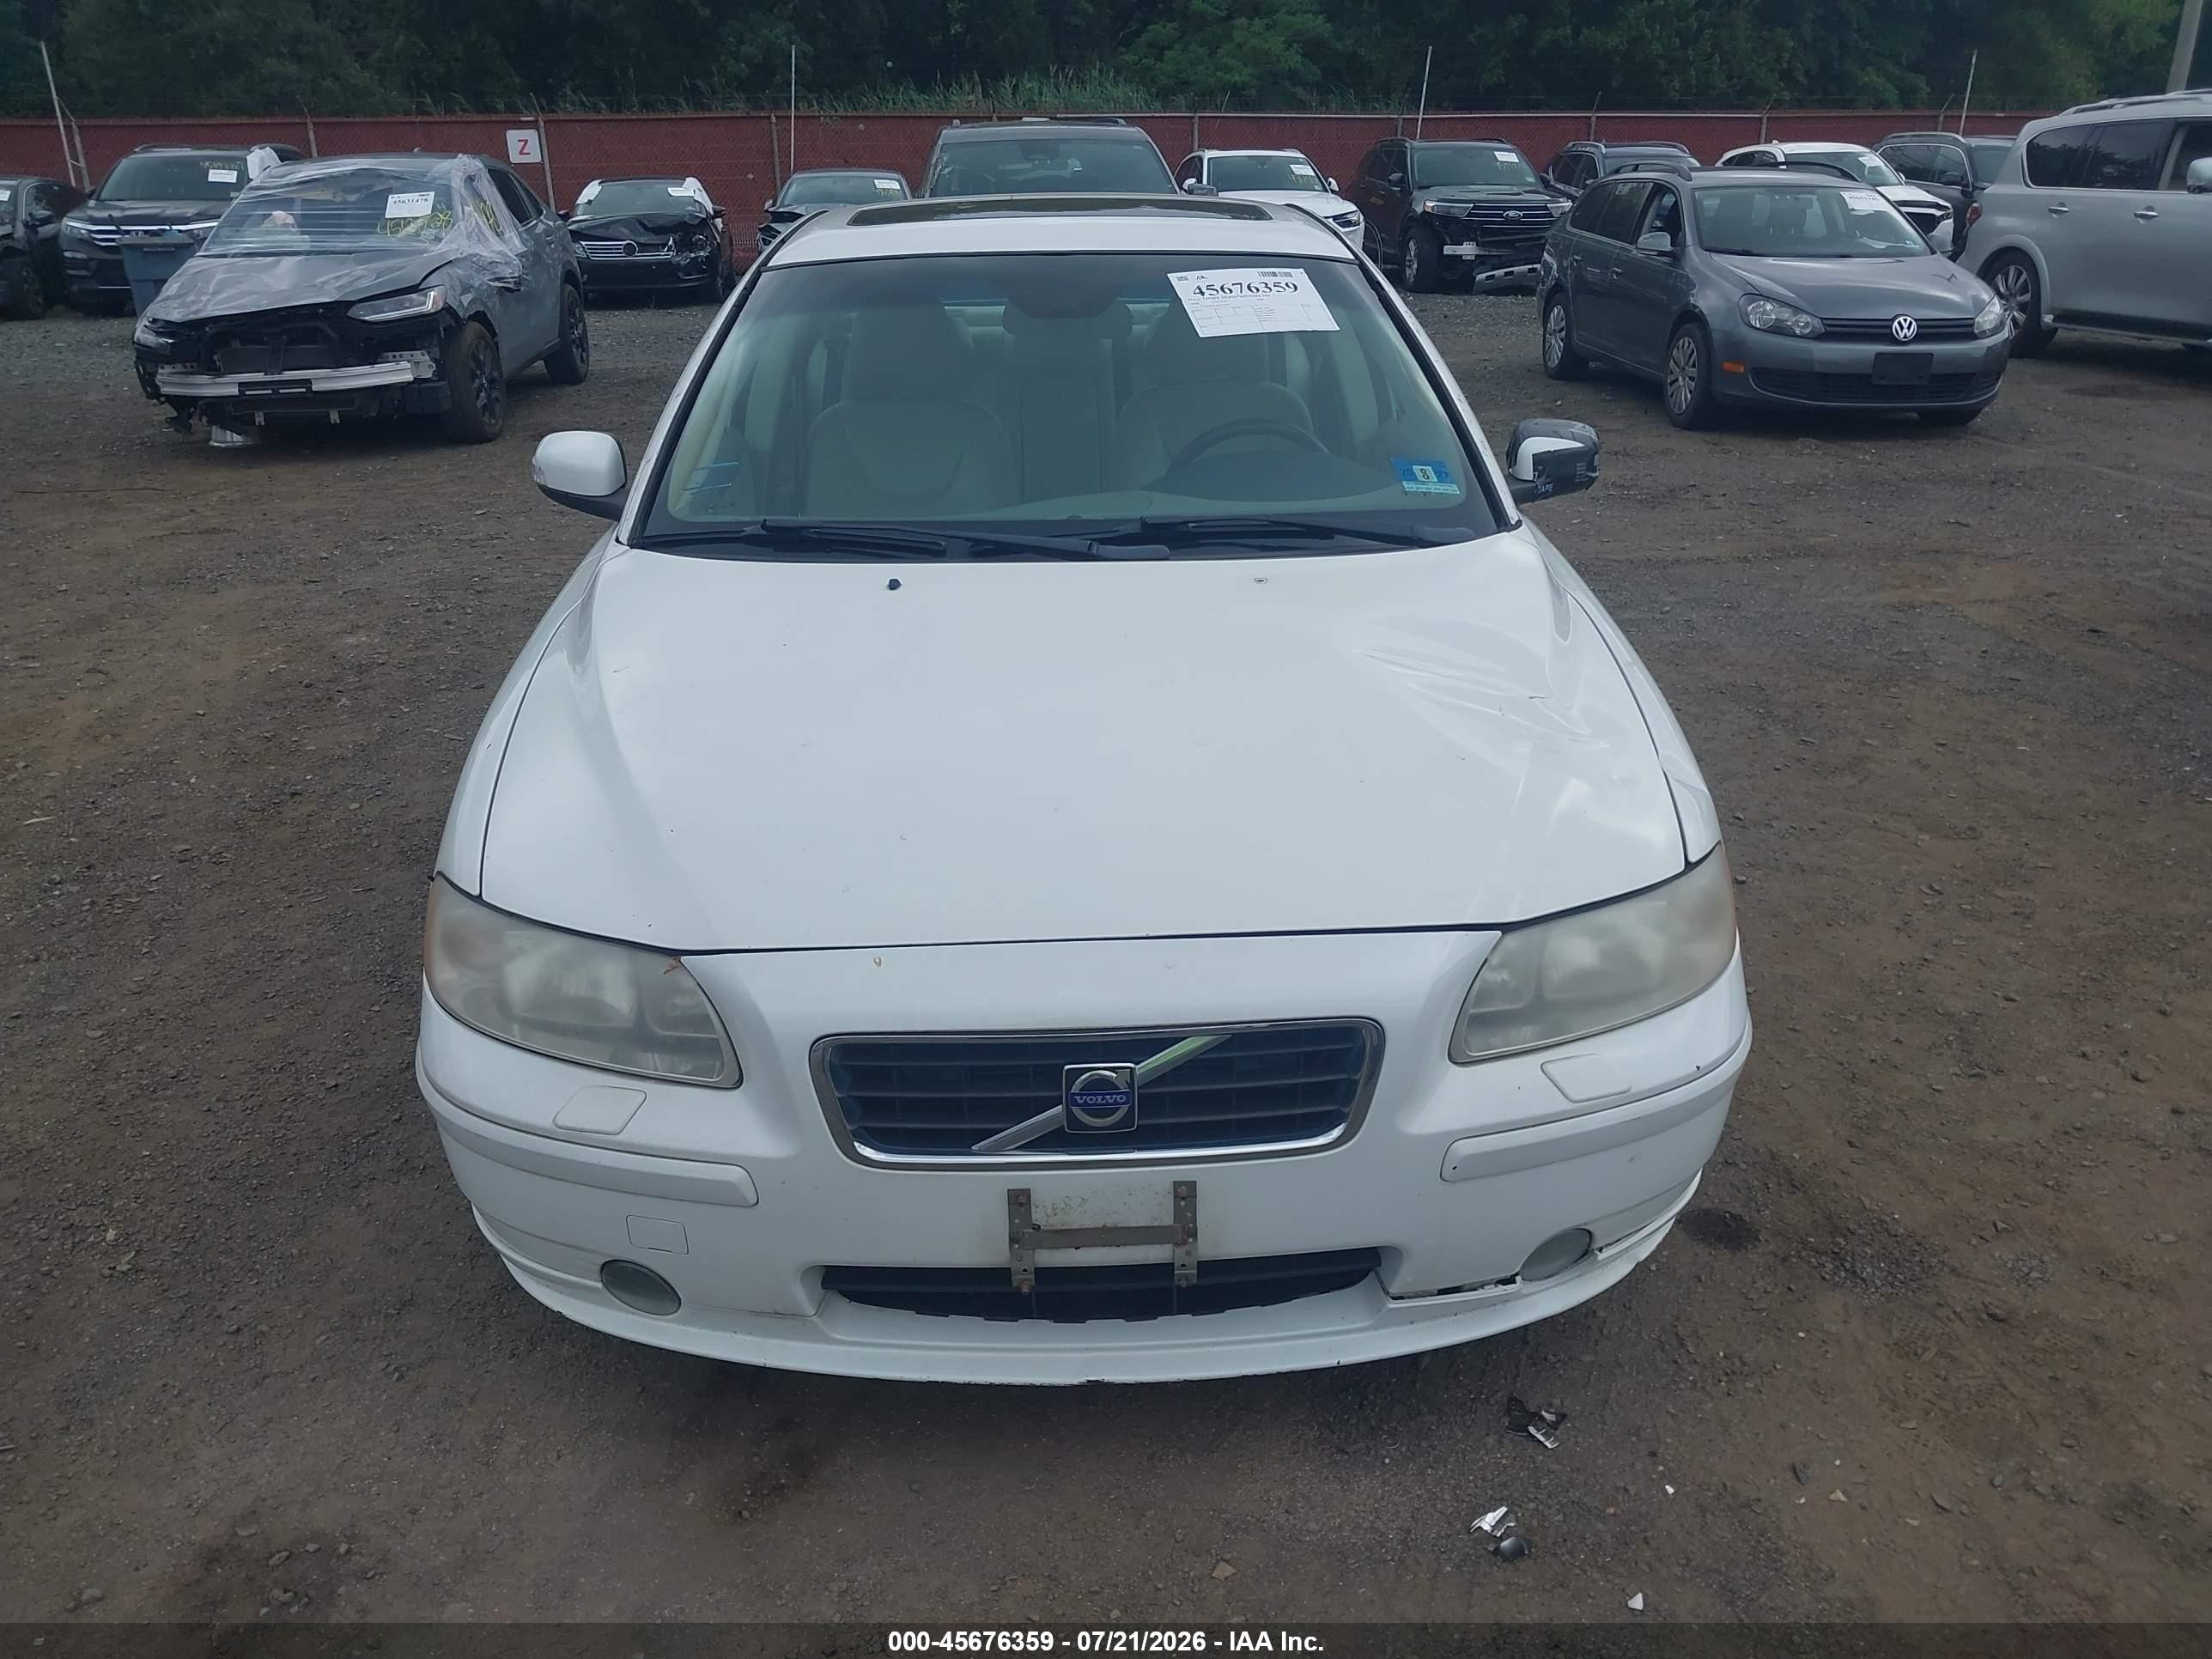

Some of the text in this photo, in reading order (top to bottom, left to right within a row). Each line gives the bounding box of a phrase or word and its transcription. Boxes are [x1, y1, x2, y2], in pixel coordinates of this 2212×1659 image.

[517, 139, 531, 155] Z
[1193, 282, 1298, 296] 45676359
[1420, 468, 1430, 480] 8
[1073, 1094, 1127, 1104] VOLVO
